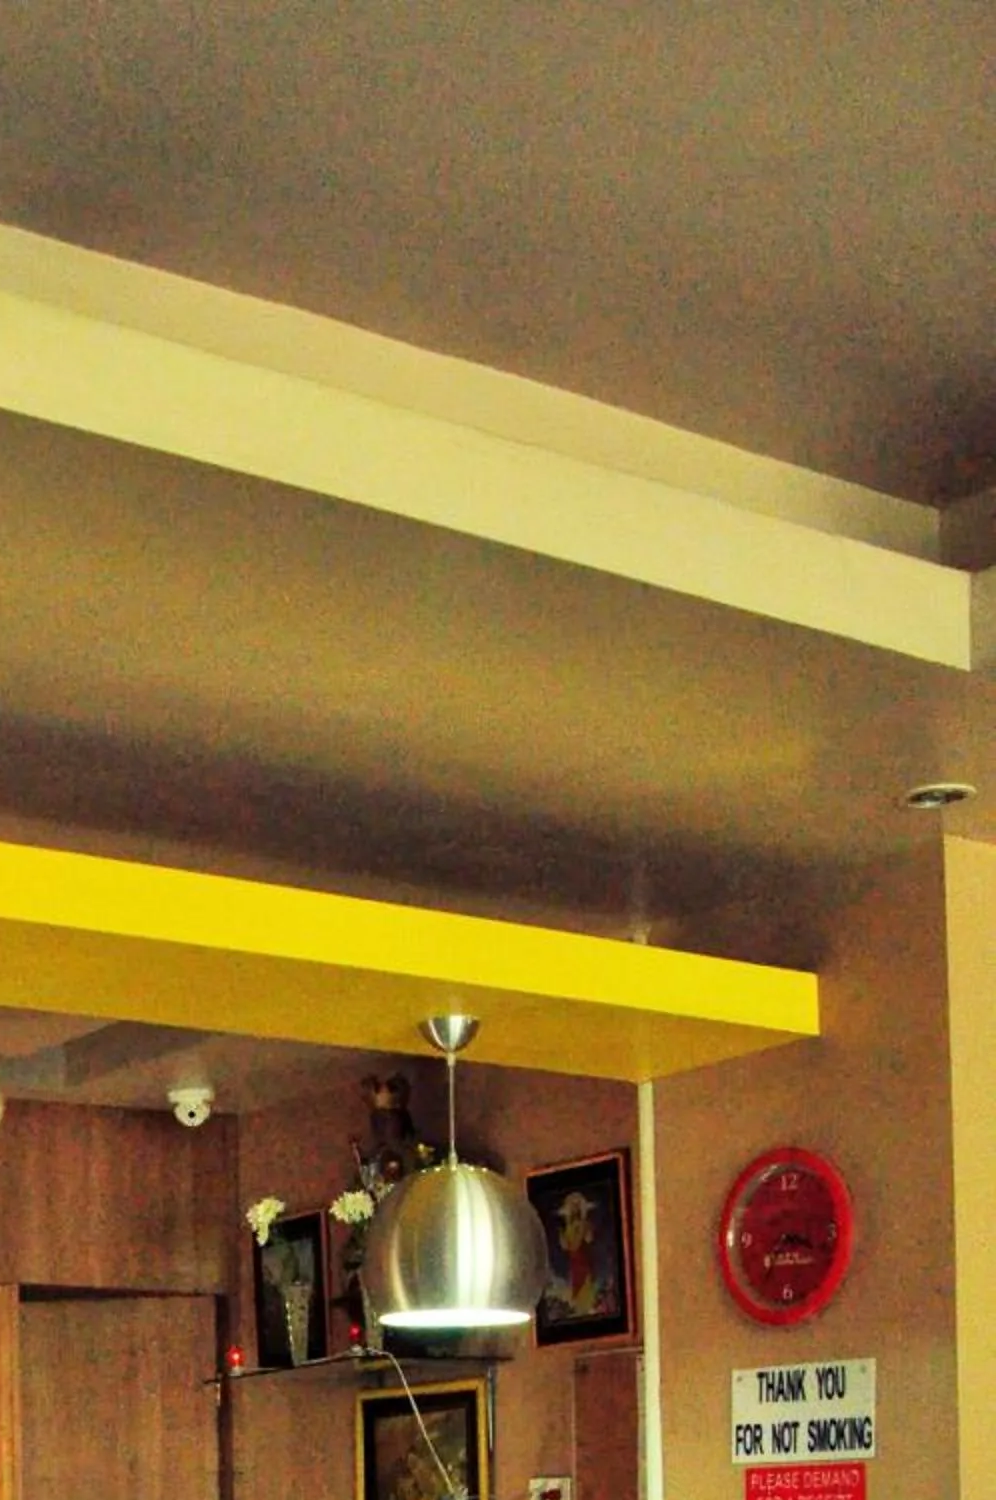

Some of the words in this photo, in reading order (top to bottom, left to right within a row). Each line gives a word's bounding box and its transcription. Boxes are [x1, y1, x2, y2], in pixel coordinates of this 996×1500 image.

[780, 1174, 798, 1191] 12
[741, 1232, 753, 1248] 9
[782, 1283, 793, 1300] 6
[756, 1370, 806, 1404] THANK
[815, 1365, 846, 1400] YOU
[735, 1423, 764, 1456] FOR
[771, 1421, 800, 1454] NOT
[807, 1415, 872, 1453] SMOKING
[751, 1471, 800, 1490] PLEASE
[803, 1469, 860, 1488] DEMAND
